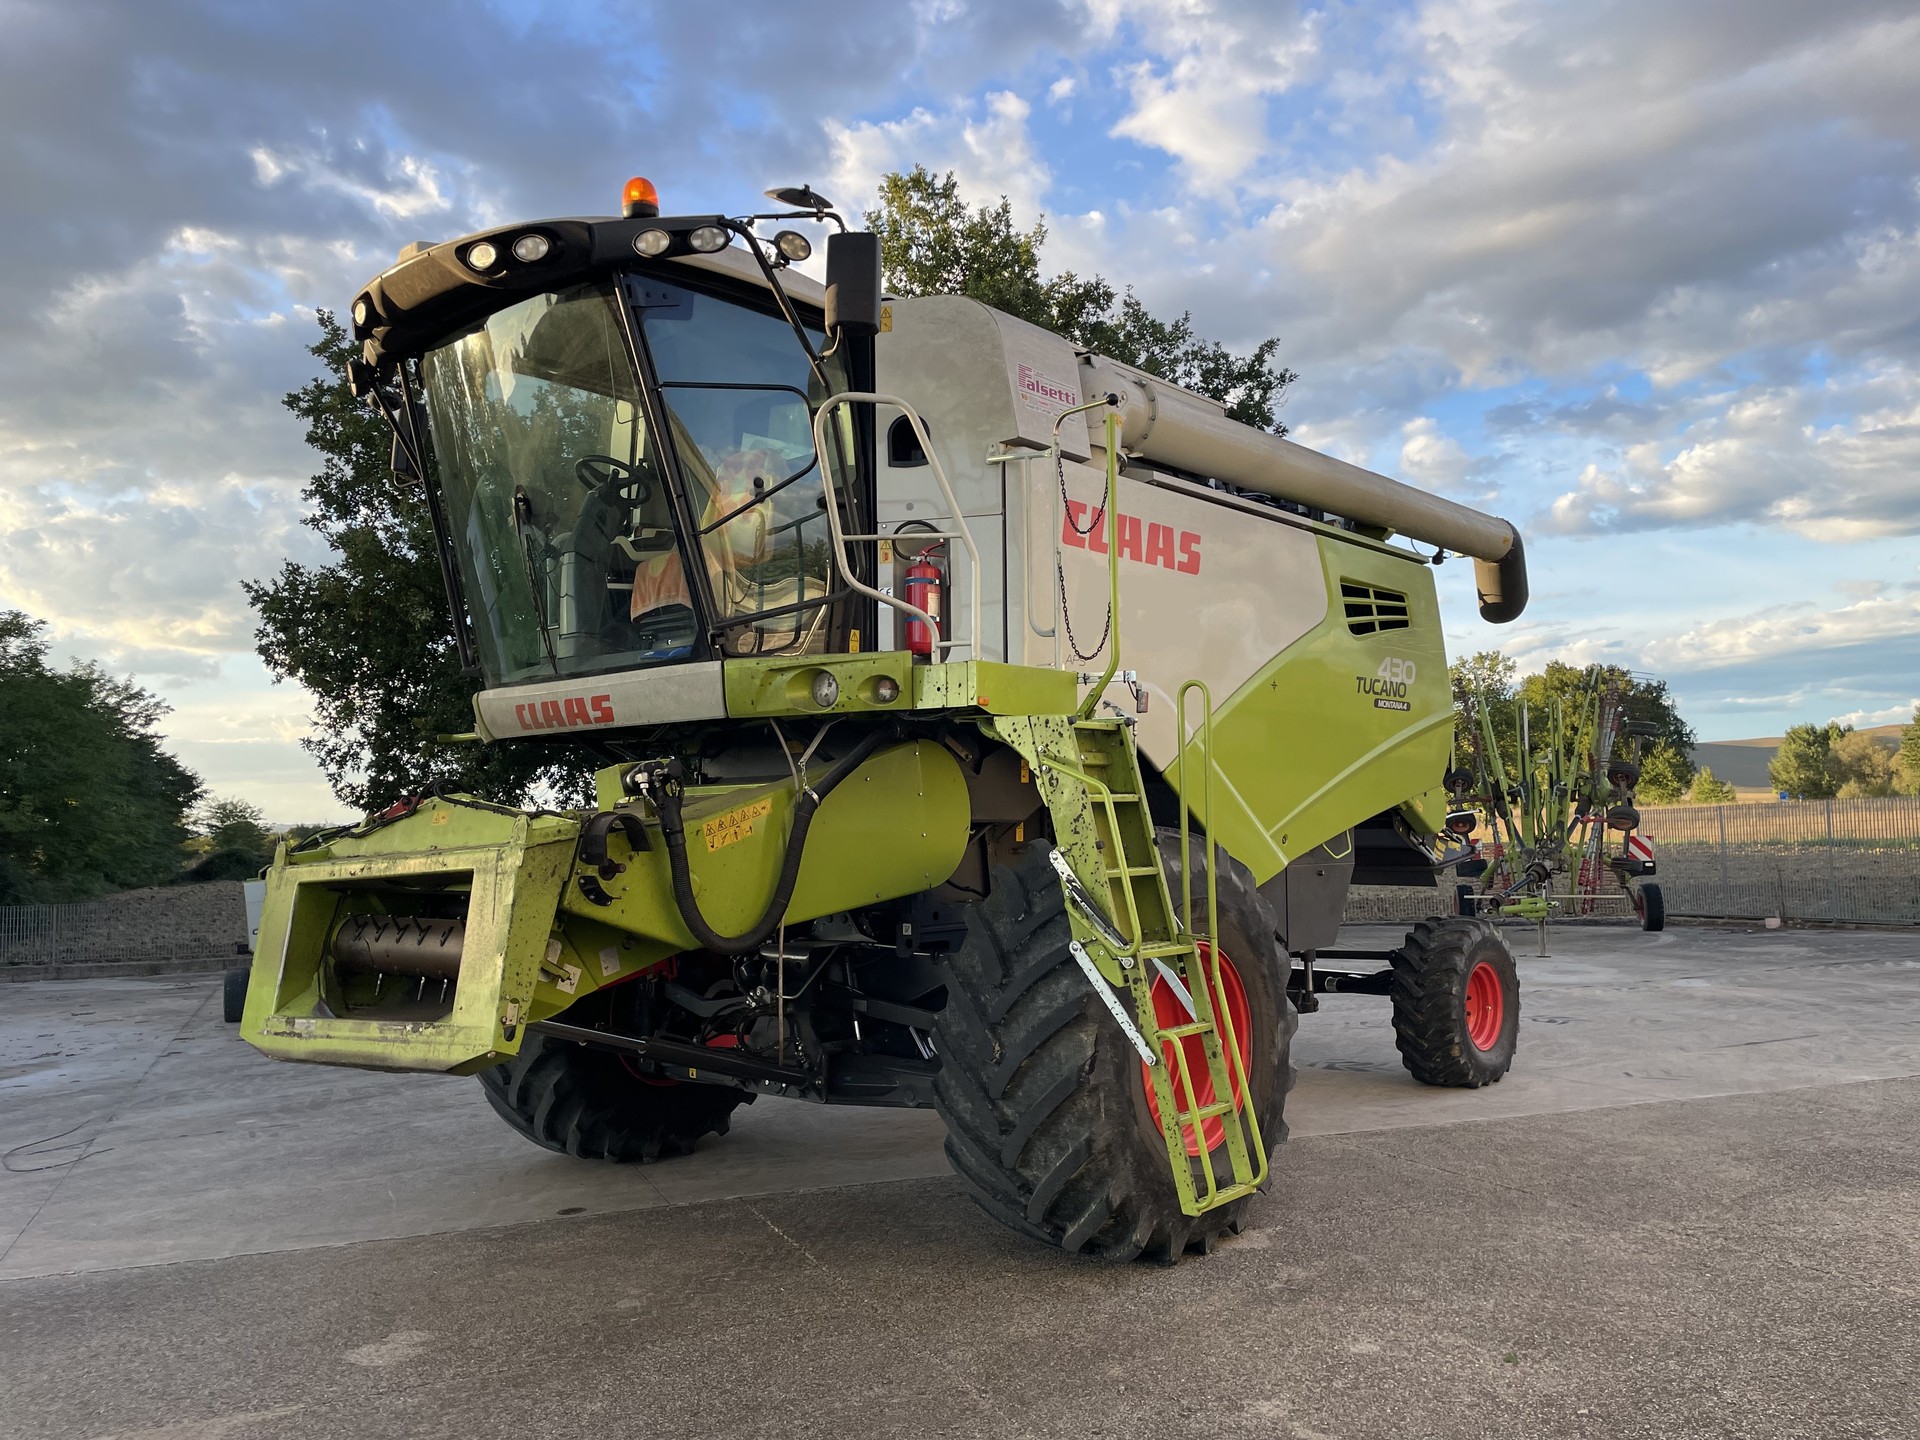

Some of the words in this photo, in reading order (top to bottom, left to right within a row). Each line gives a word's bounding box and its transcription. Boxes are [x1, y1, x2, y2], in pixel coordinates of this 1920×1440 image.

[1018, 363, 1076, 406] Falsetti
[1062, 499, 1202, 576] CLAAS
[1356, 676, 1407, 698] TUCANO
[1377, 656, 1416, 685] 430
[515, 694, 615, 731] CLAAS
